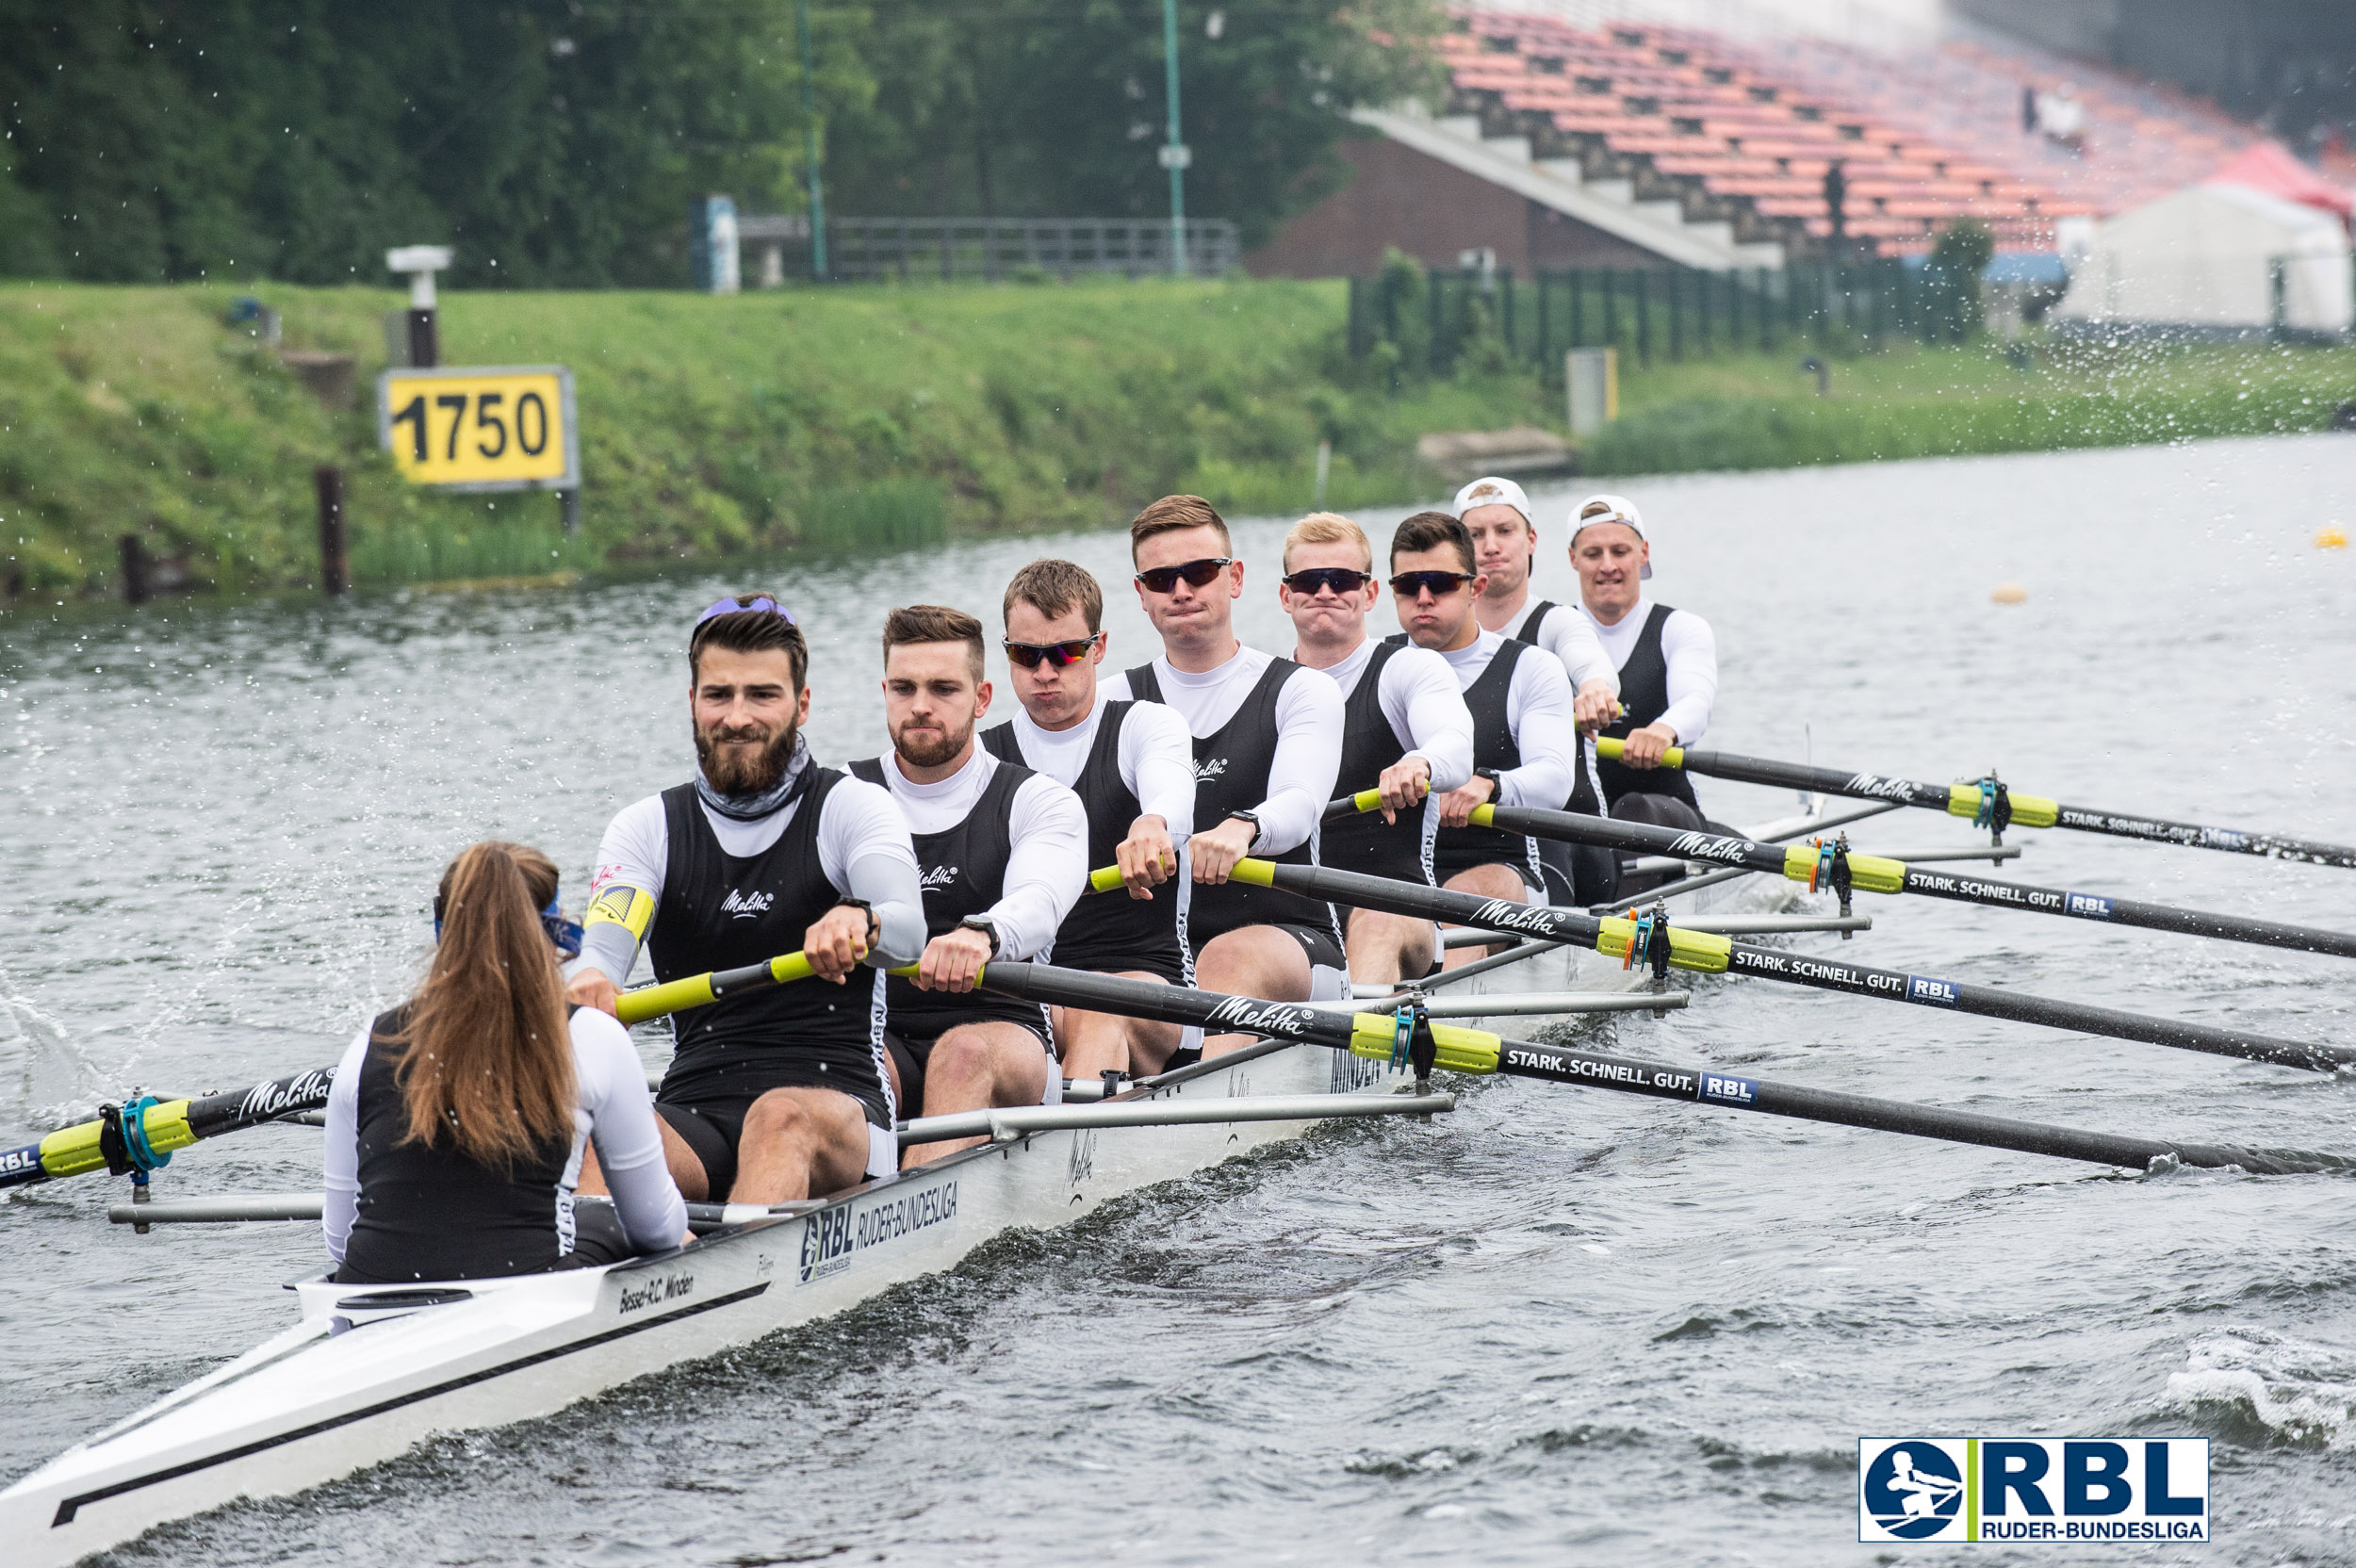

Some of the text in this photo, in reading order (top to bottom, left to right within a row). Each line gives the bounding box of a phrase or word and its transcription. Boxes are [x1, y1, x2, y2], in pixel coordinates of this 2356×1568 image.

[391, 392, 548, 463] 1750
[1909, 873, 2061, 908] STARK. SCHNELL. GUT.
[2072, 896, 2110, 914] RBL
[1736, 952, 1902, 991] STARK. SCHNELL. GUT.
[1914, 980, 1955, 999] RBL
[1508, 1050, 1693, 1091] STARK. SCHNELL. GUT.
[1707, 1077, 1752, 1099] RBL
[819, 1203, 853, 1262] RBL
[856, 1181, 958, 1250] RUDER-BUNDESLIGA
[664, 1270, 694, 1300] Minden
